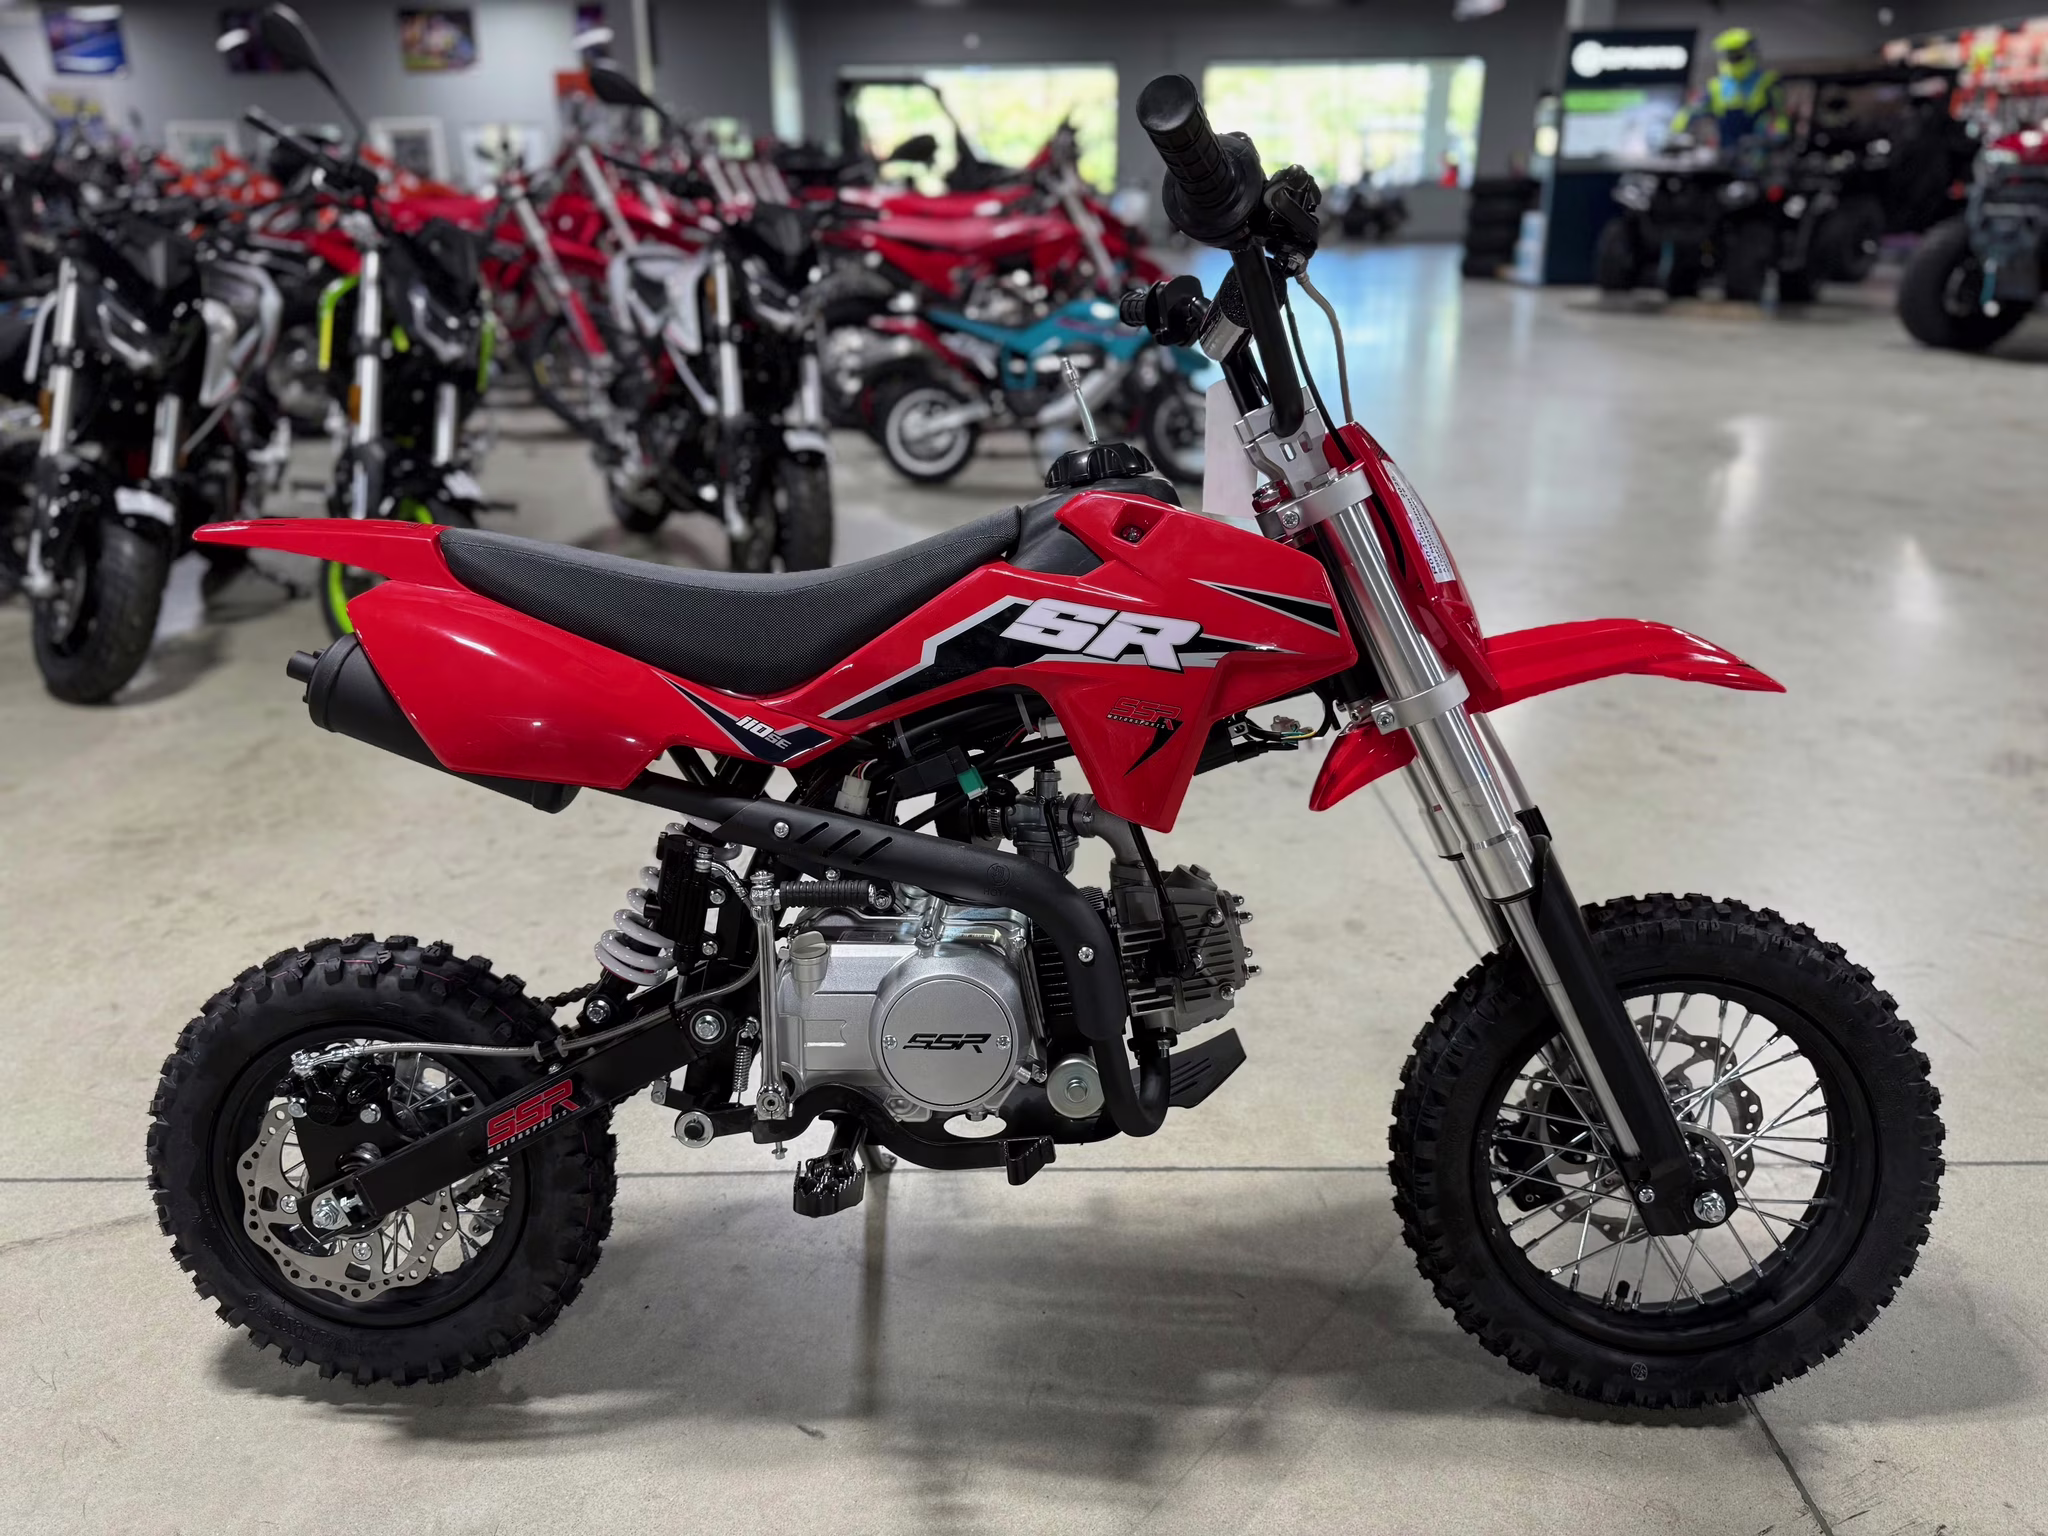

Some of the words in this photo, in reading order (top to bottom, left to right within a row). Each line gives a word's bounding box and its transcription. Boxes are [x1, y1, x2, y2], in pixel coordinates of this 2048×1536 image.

[999, 597, 1202, 673] SR
[1107, 714, 1166, 730] MOTORSPORTS
[1108, 697, 1182, 731] SSR
[902, 1033, 992, 1053] SSR
[487, 1079, 580, 1149] SSR
[487, 1109, 567, 1155] MOTORSPORTS
